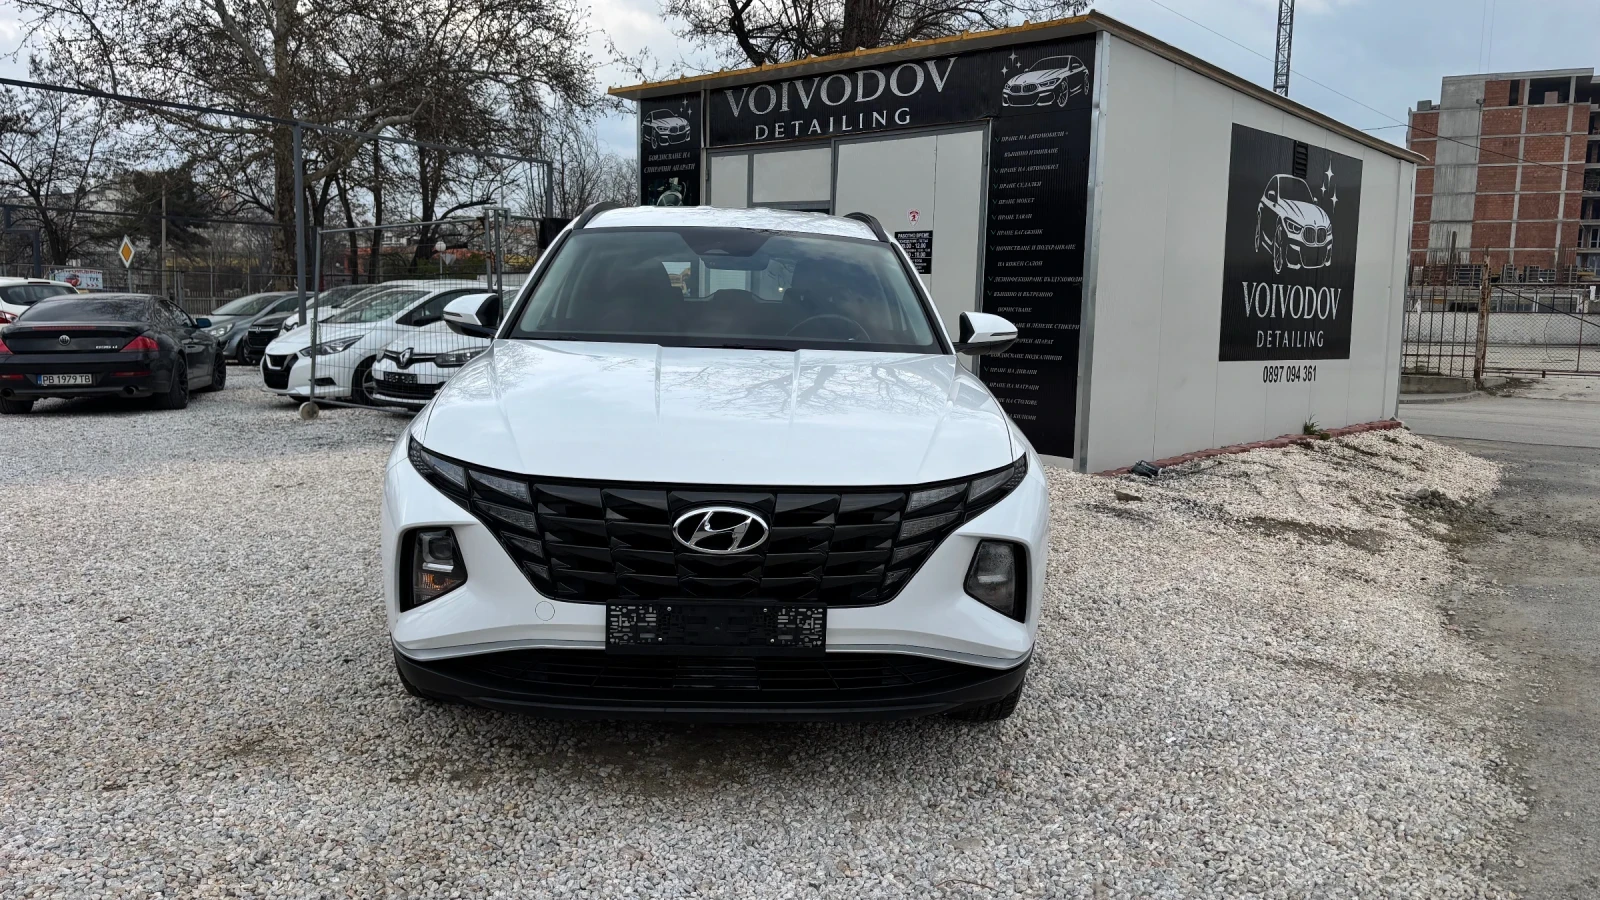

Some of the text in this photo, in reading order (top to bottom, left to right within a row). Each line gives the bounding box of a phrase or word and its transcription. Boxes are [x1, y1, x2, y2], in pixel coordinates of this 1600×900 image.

[724, 57, 958, 118] VOIVODOV
[755, 108, 910, 140] DETAILING
[1242, 282, 1342, 320] VOIVODOV
[1256, 330, 1324, 348] DETAILING
[1263, 365, 1317, 383] 0897 094 361
